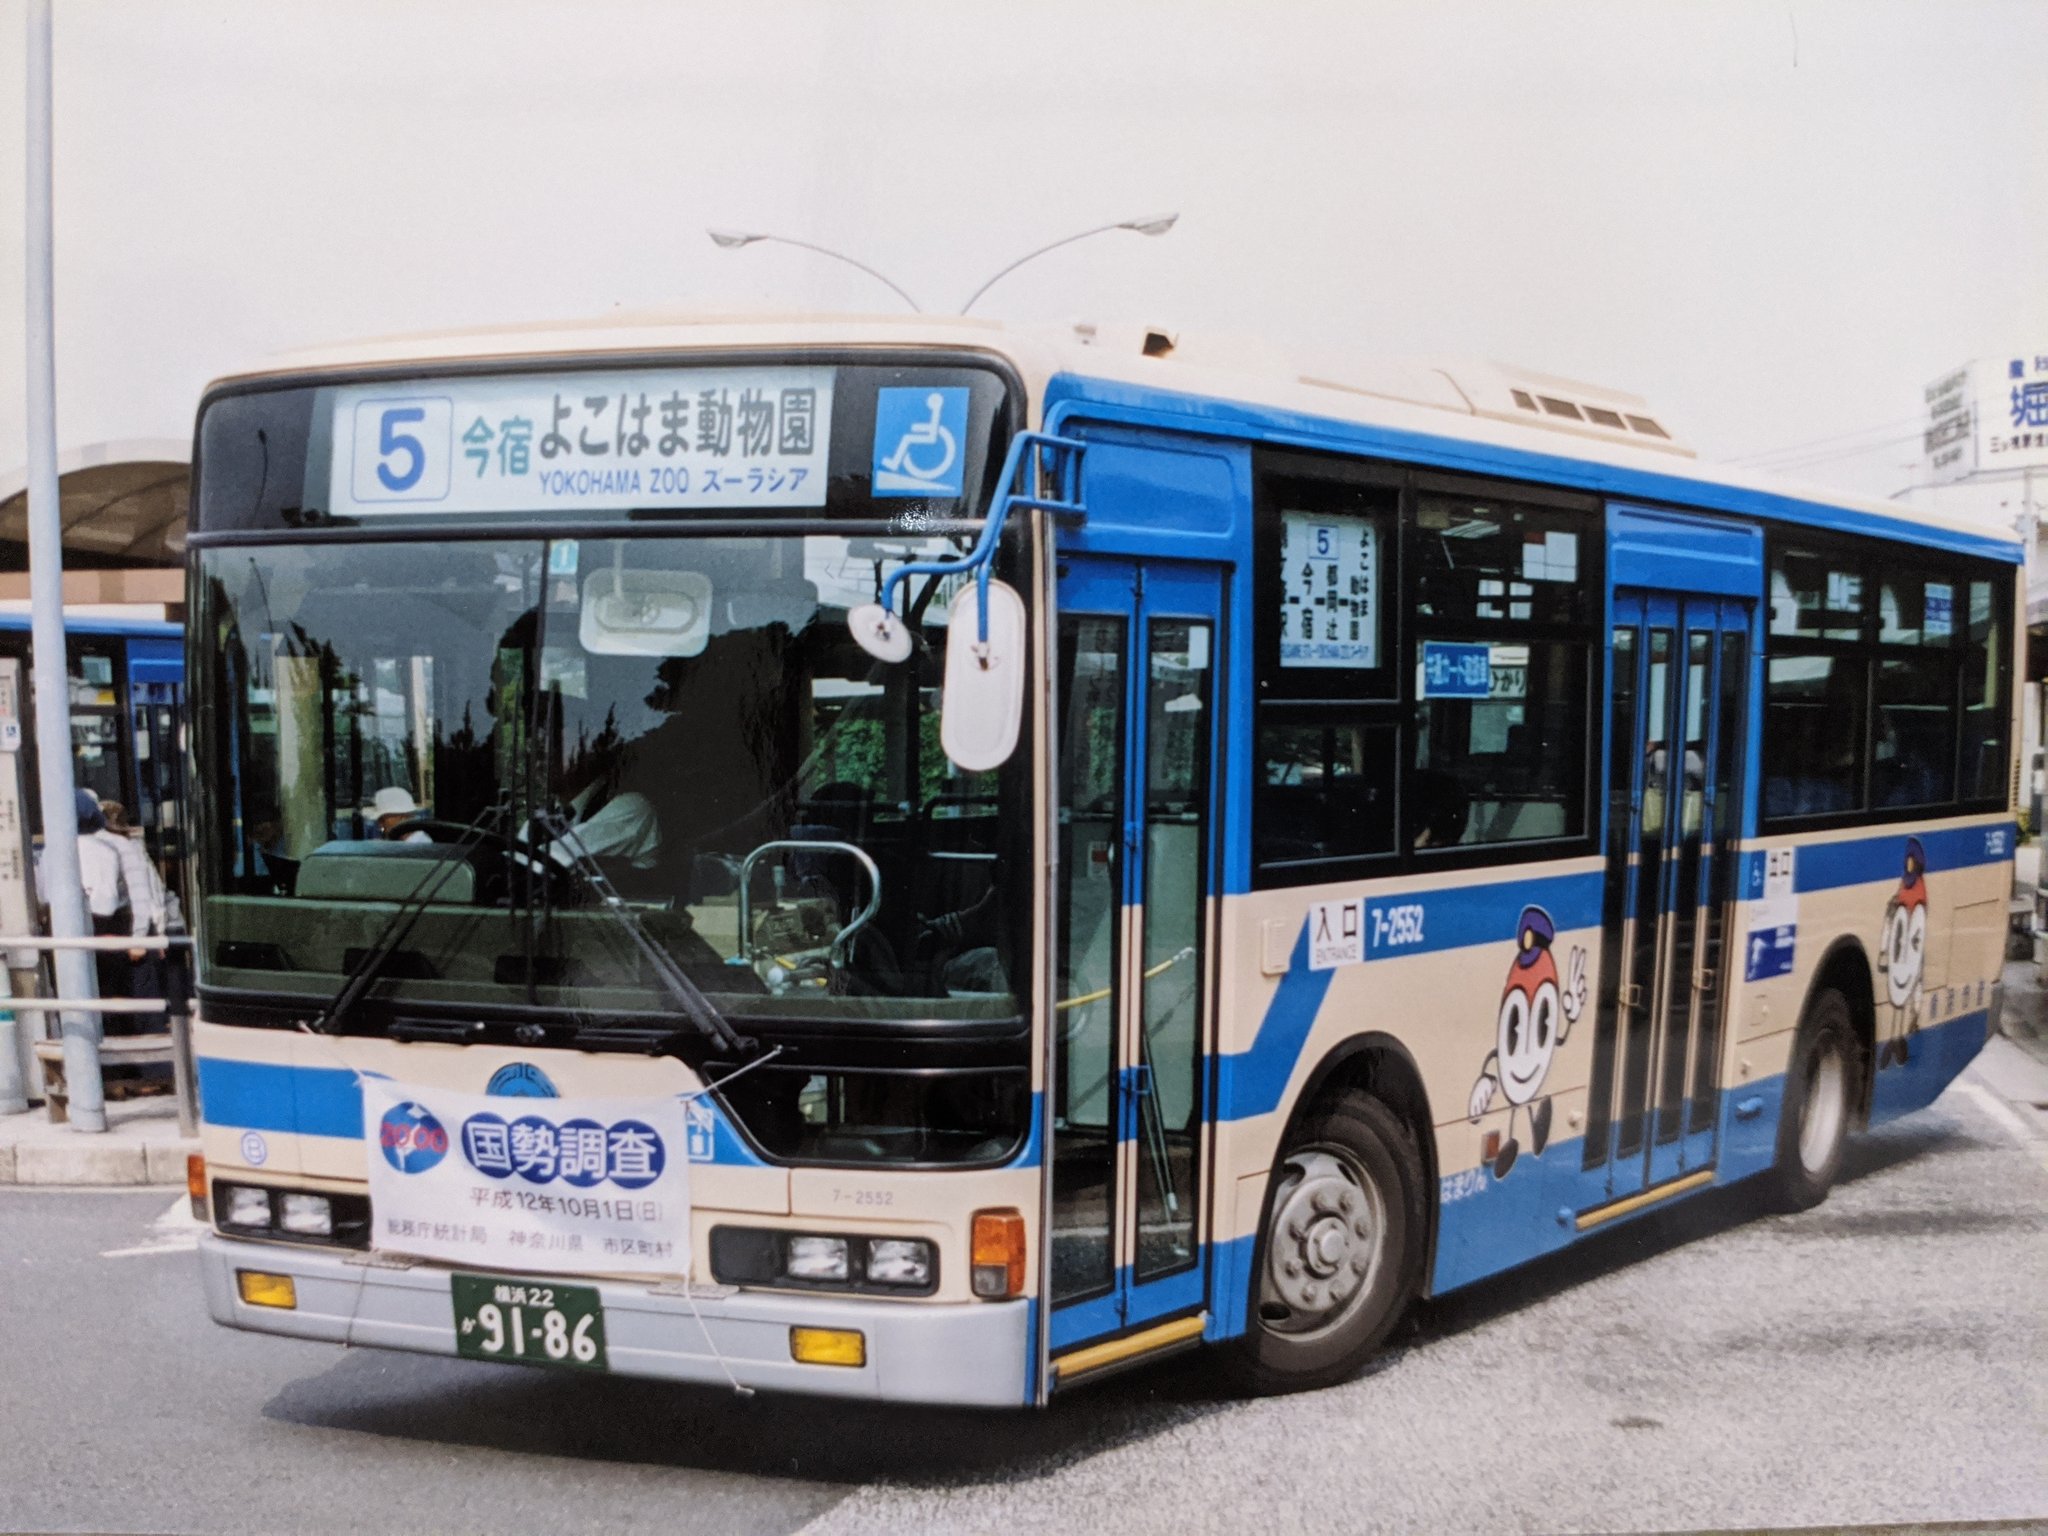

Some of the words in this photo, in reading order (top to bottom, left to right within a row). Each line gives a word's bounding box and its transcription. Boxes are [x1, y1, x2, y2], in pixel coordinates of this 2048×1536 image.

[540, 387, 815, 459] よこはま動物園
[377, 407, 425, 492] 5
[461, 415, 533, 478] 今宿
[540, 469, 640, 496] YOKOHAMA
[649, 467, 689, 495] ZOO
[702, 468, 808, 494] ズーラシア
[1317, 529, 1329, 555] 5
[1316, 905, 1357, 942] 入口
[1371, 905, 1424, 948] 7-2552
[466, 1121, 658, 1180] 国勢調査
[833, 1189, 893, 1206] 7-2552
[509, 1229, 584, 1251] 神奈川県
[478, 1303, 597, 1363] 91-86
